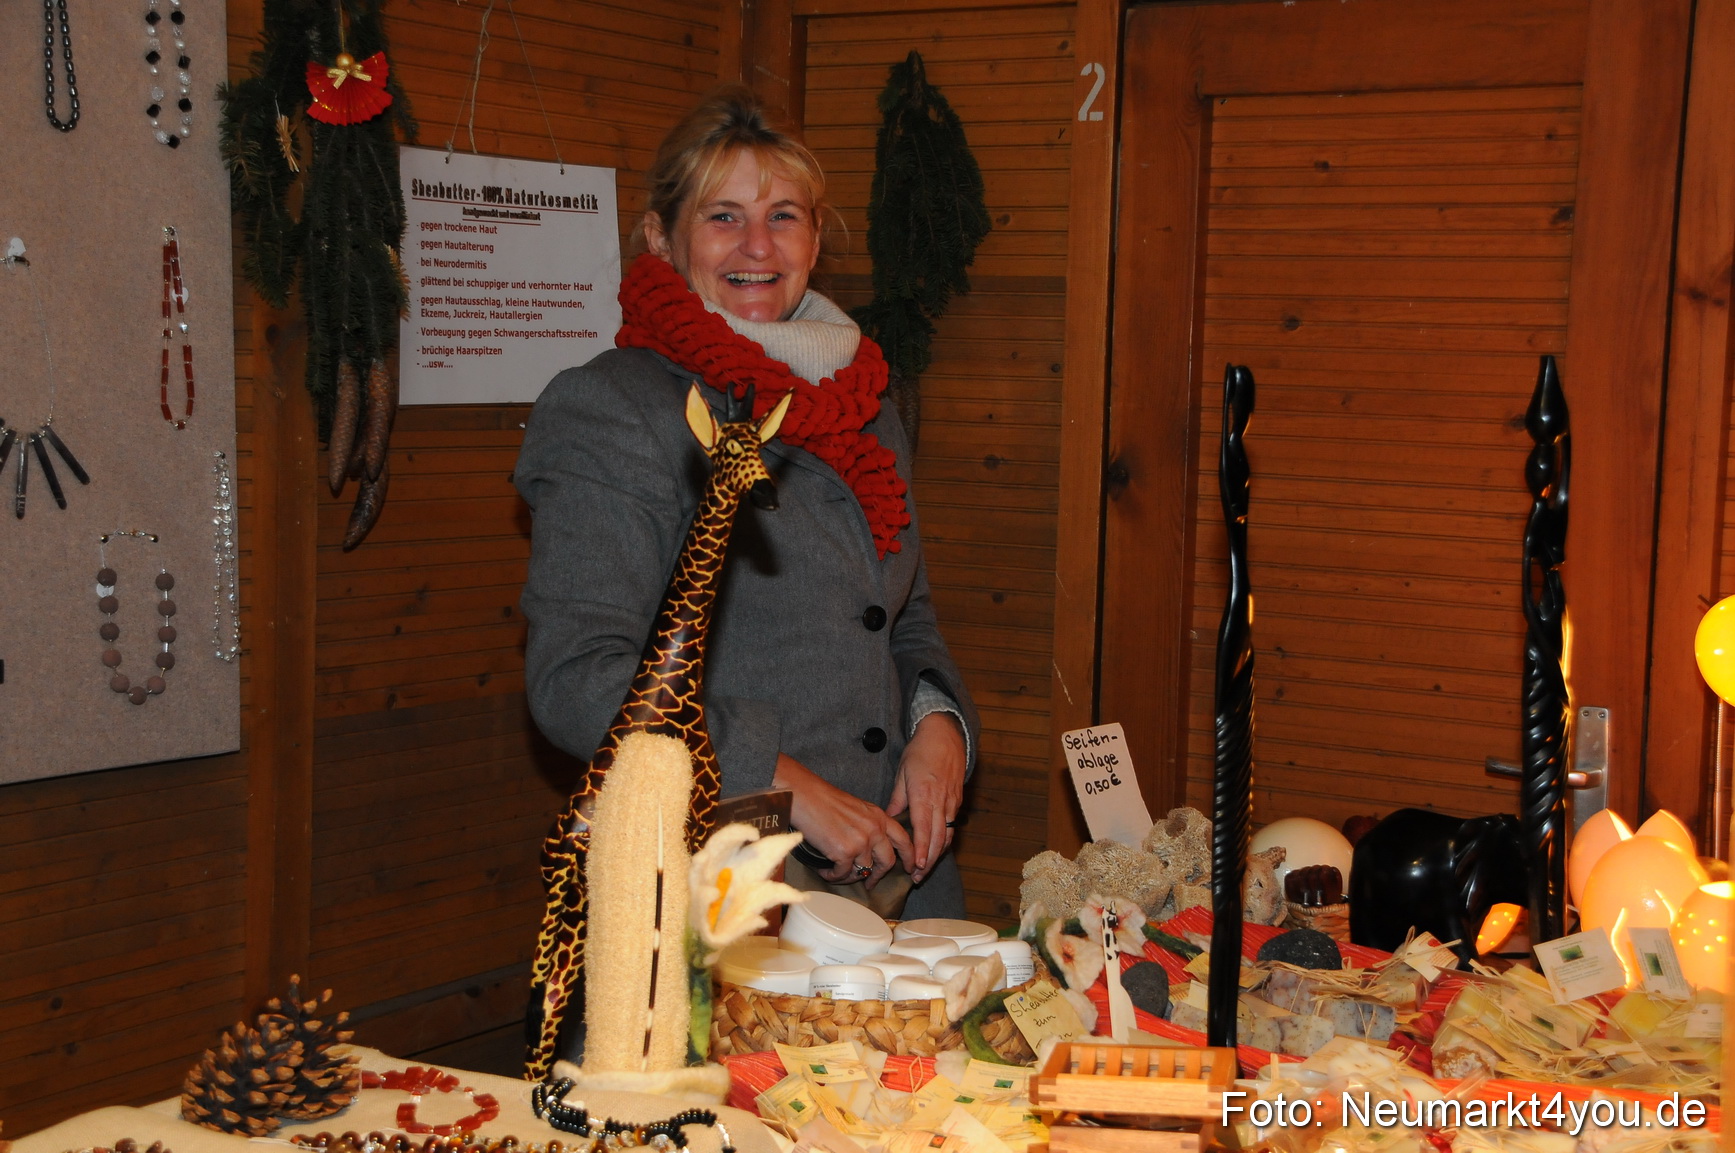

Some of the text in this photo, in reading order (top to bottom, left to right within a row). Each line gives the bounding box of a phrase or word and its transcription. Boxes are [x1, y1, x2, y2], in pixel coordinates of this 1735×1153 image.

[1078, 62, 1106, 122] 2
[420, 222, 498, 234] gegen trockene Haut
[420, 240, 494, 254] gegen Hautalterung
[420, 257, 487, 270] bei Neurodermitis
[420, 277, 593, 291] glättend bei schuppiger und verhornter Haut
[420, 296, 585, 309] gegen Hautausschlag, kleine Hautwunden,
[420, 309, 543, 321] Ekzeme, Juckreiz, Hautallergien
[420, 327, 598, 339] Vorbeugung gegen Schwangerschaftsstreifen
[421, 345, 503, 357] brüchige Haarspitzen
[1064, 729, 1118, 750] Seifen-
[1077, 752, 1119, 773] ablage
[1085, 773, 1122, 795] 0,50€
[1010, 989, 1059, 1018] Sheabutter
